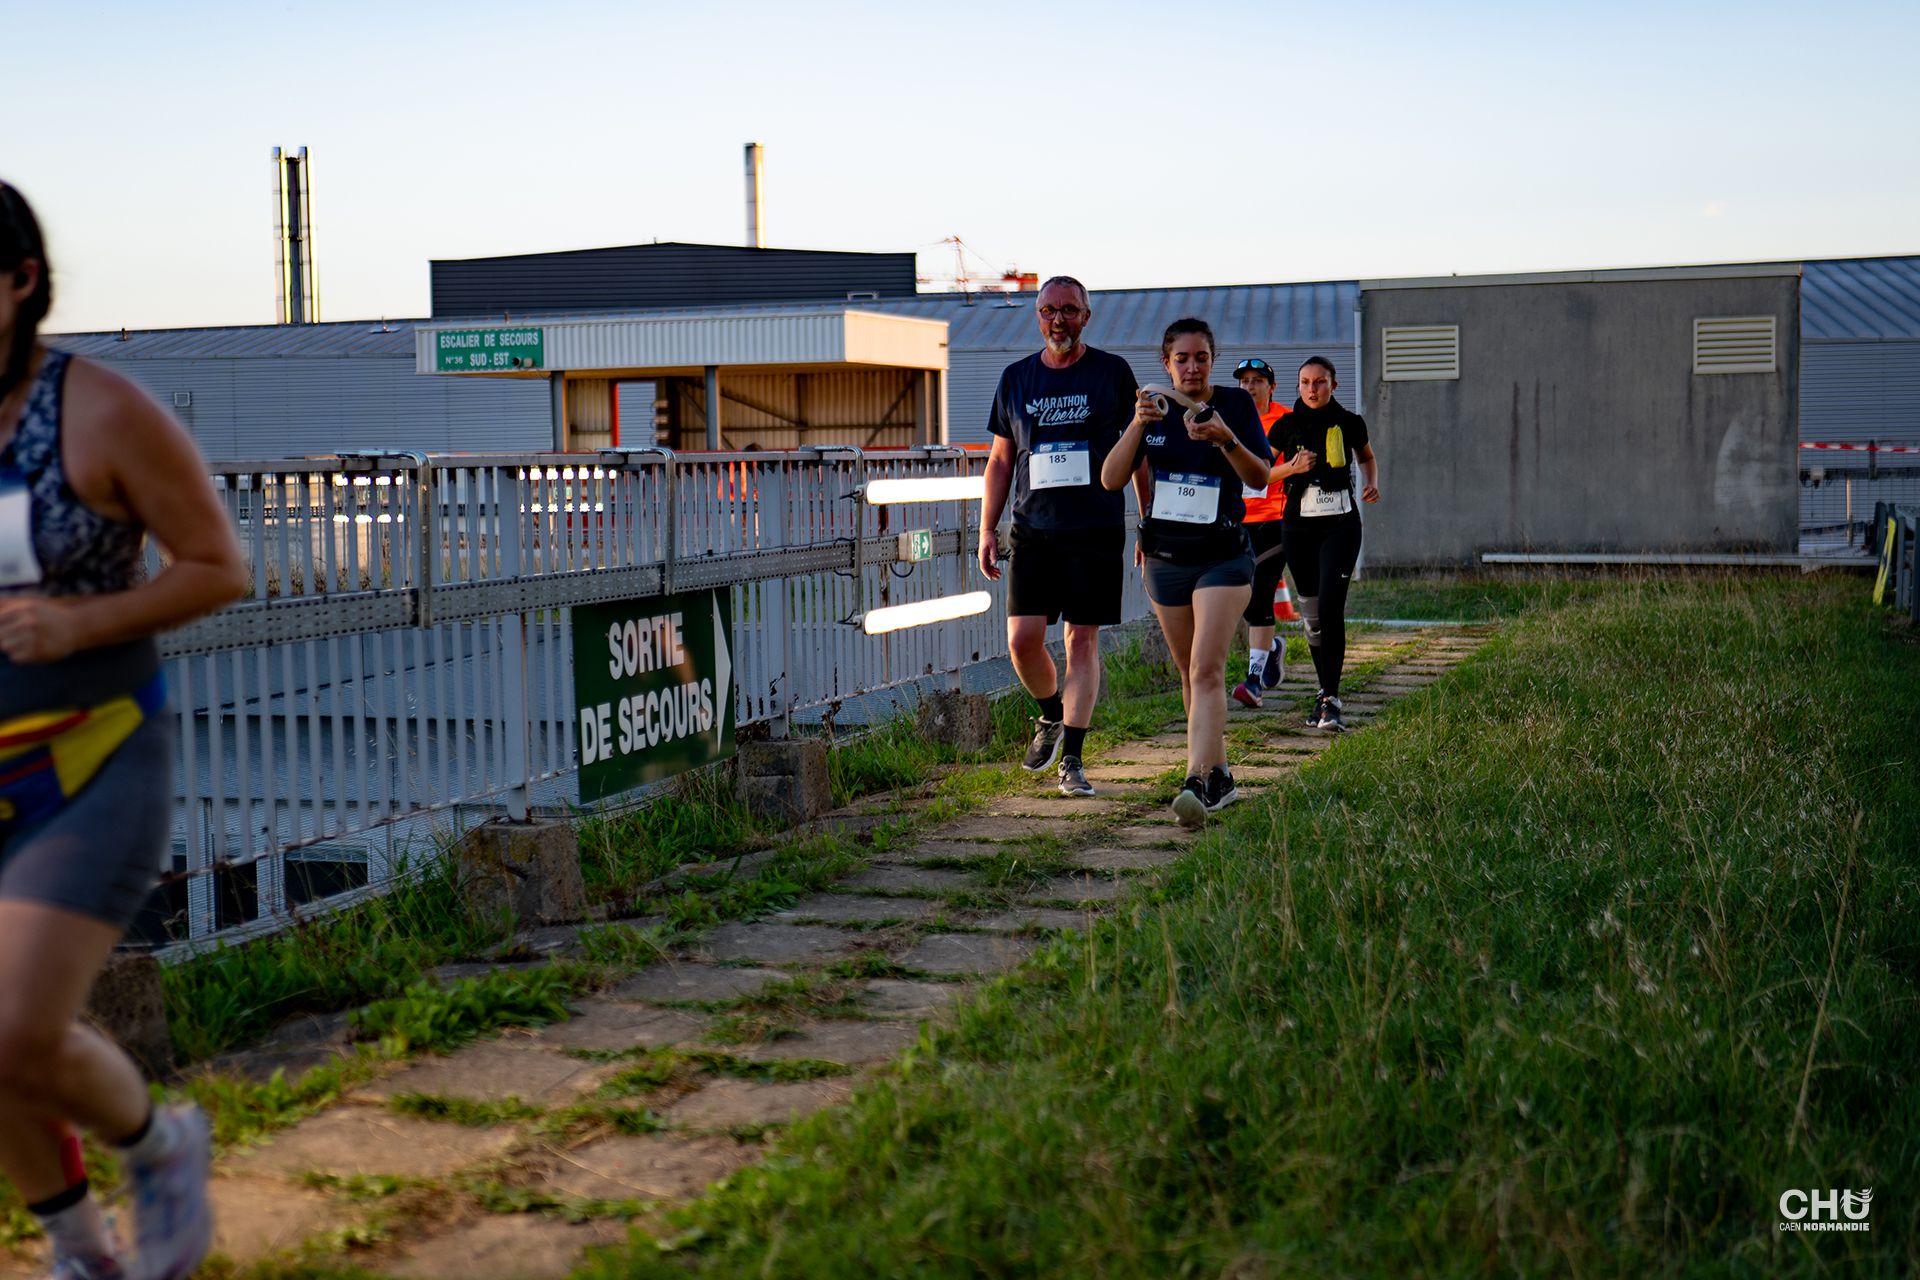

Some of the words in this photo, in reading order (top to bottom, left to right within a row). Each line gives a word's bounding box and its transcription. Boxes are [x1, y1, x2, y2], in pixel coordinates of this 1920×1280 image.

[440, 334, 480, 349] ESCALIER
[484, 333, 496, 347] DE
[499, 332, 539, 346] SECOURS
[469, 353, 487, 366] SUD
[493, 352, 510, 365] EST
[1032, 394, 1088, 411] MARATHON
[1038, 405, 1092, 427] Liberté
[1145, 434, 1166, 444] CHU
[1049, 454, 1067, 464] 185
[1178, 486, 1196, 497] 180
[608, 611, 685, 681] SORTIE
[580, 702, 613, 766] DE
[618, 677, 713, 755] SECOURS
